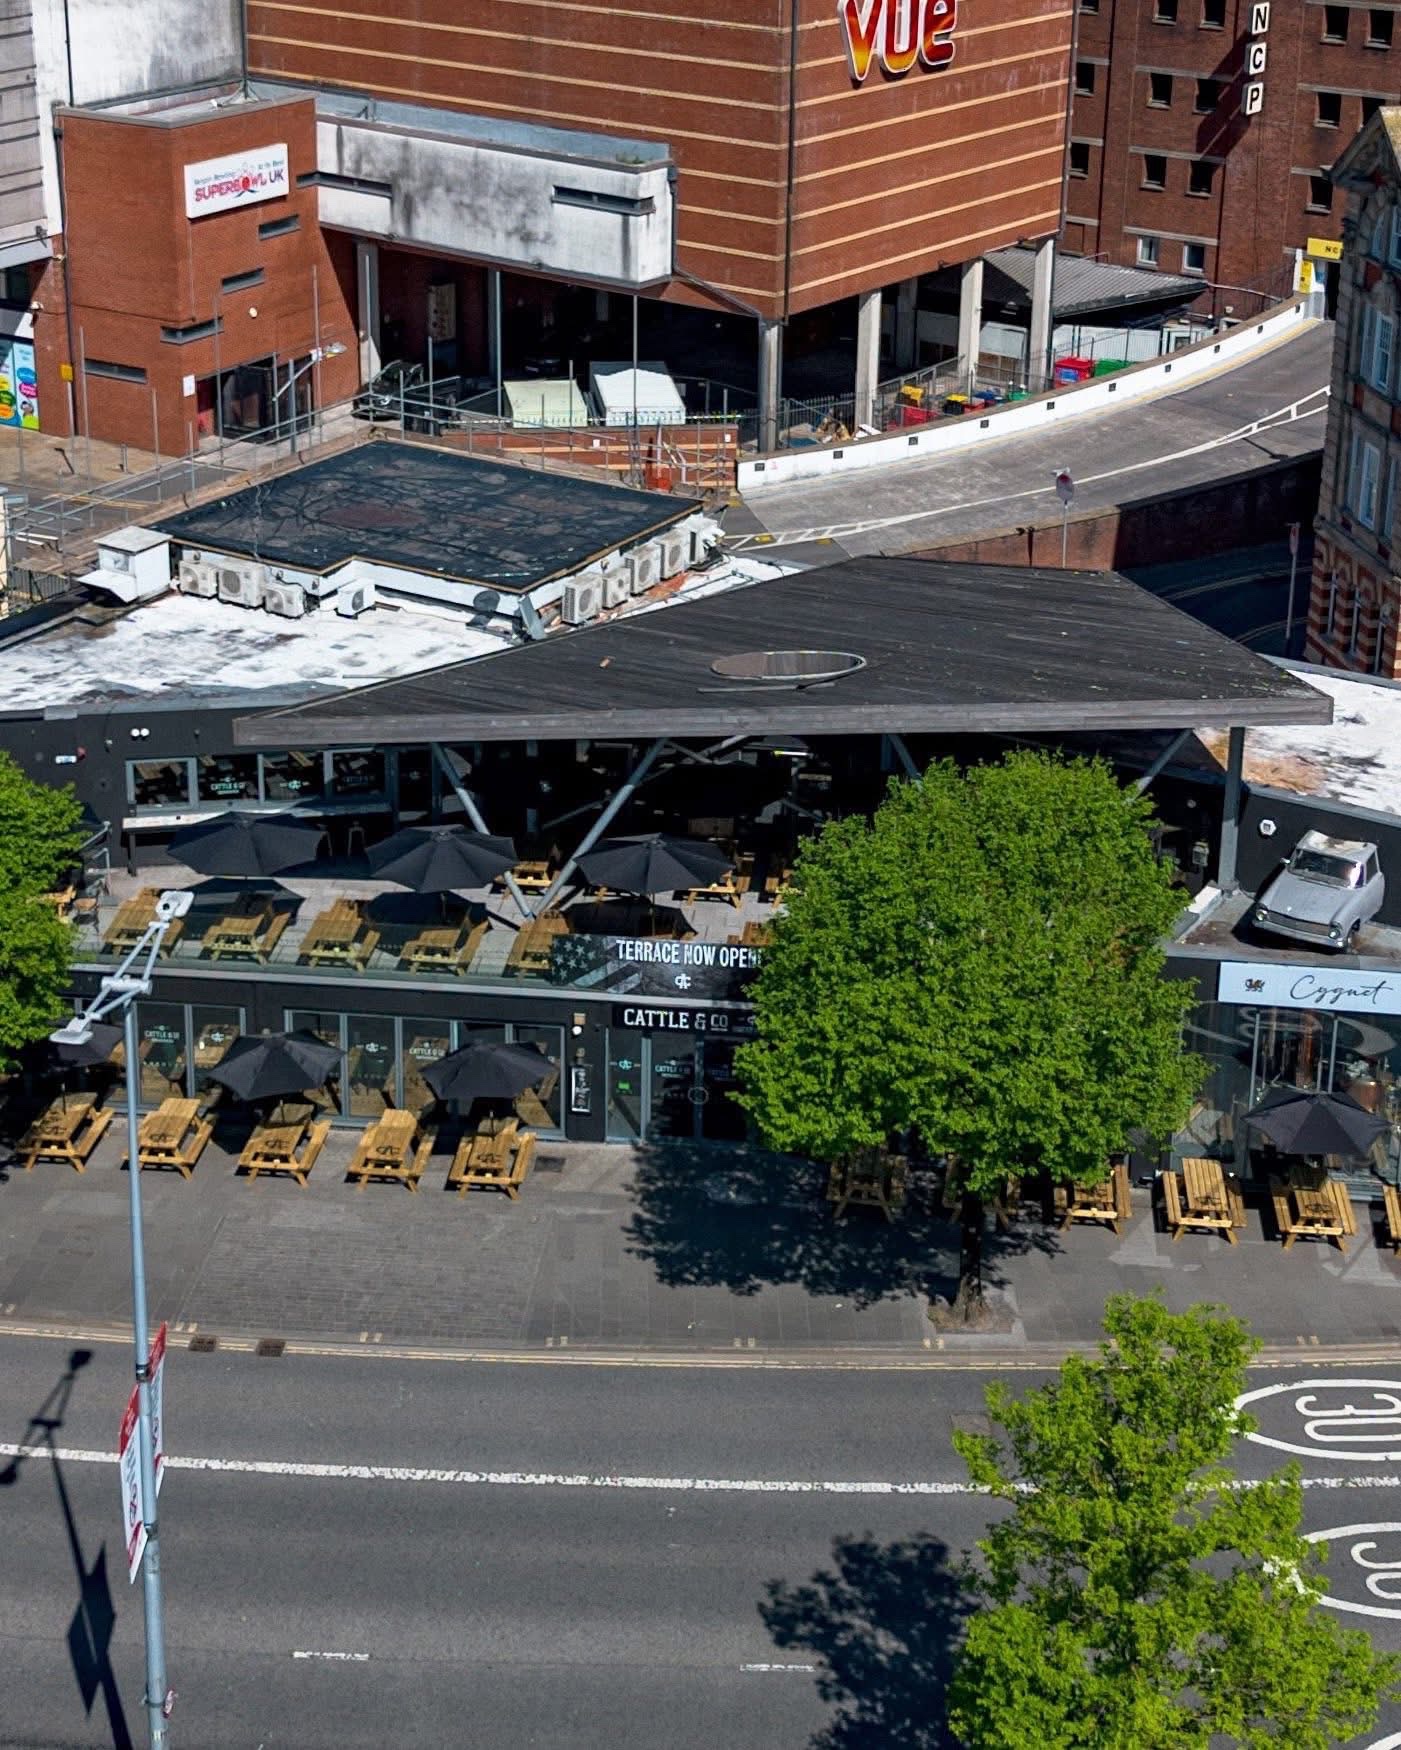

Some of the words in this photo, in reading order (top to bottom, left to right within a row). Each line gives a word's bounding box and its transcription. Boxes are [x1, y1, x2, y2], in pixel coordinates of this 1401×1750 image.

[1249, 6, 1268, 111] NCP
[269, 169, 284, 183] UK
[616, 939, 680, 964] TERRACE
[684, 944, 717, 966] NOW
[1290, 974, 1393, 1005] Cygnet
[623, 1008, 690, 1029] CATTLE
[694, 1013, 707, 1030] &
[710, 1014, 728, 1029] CO
